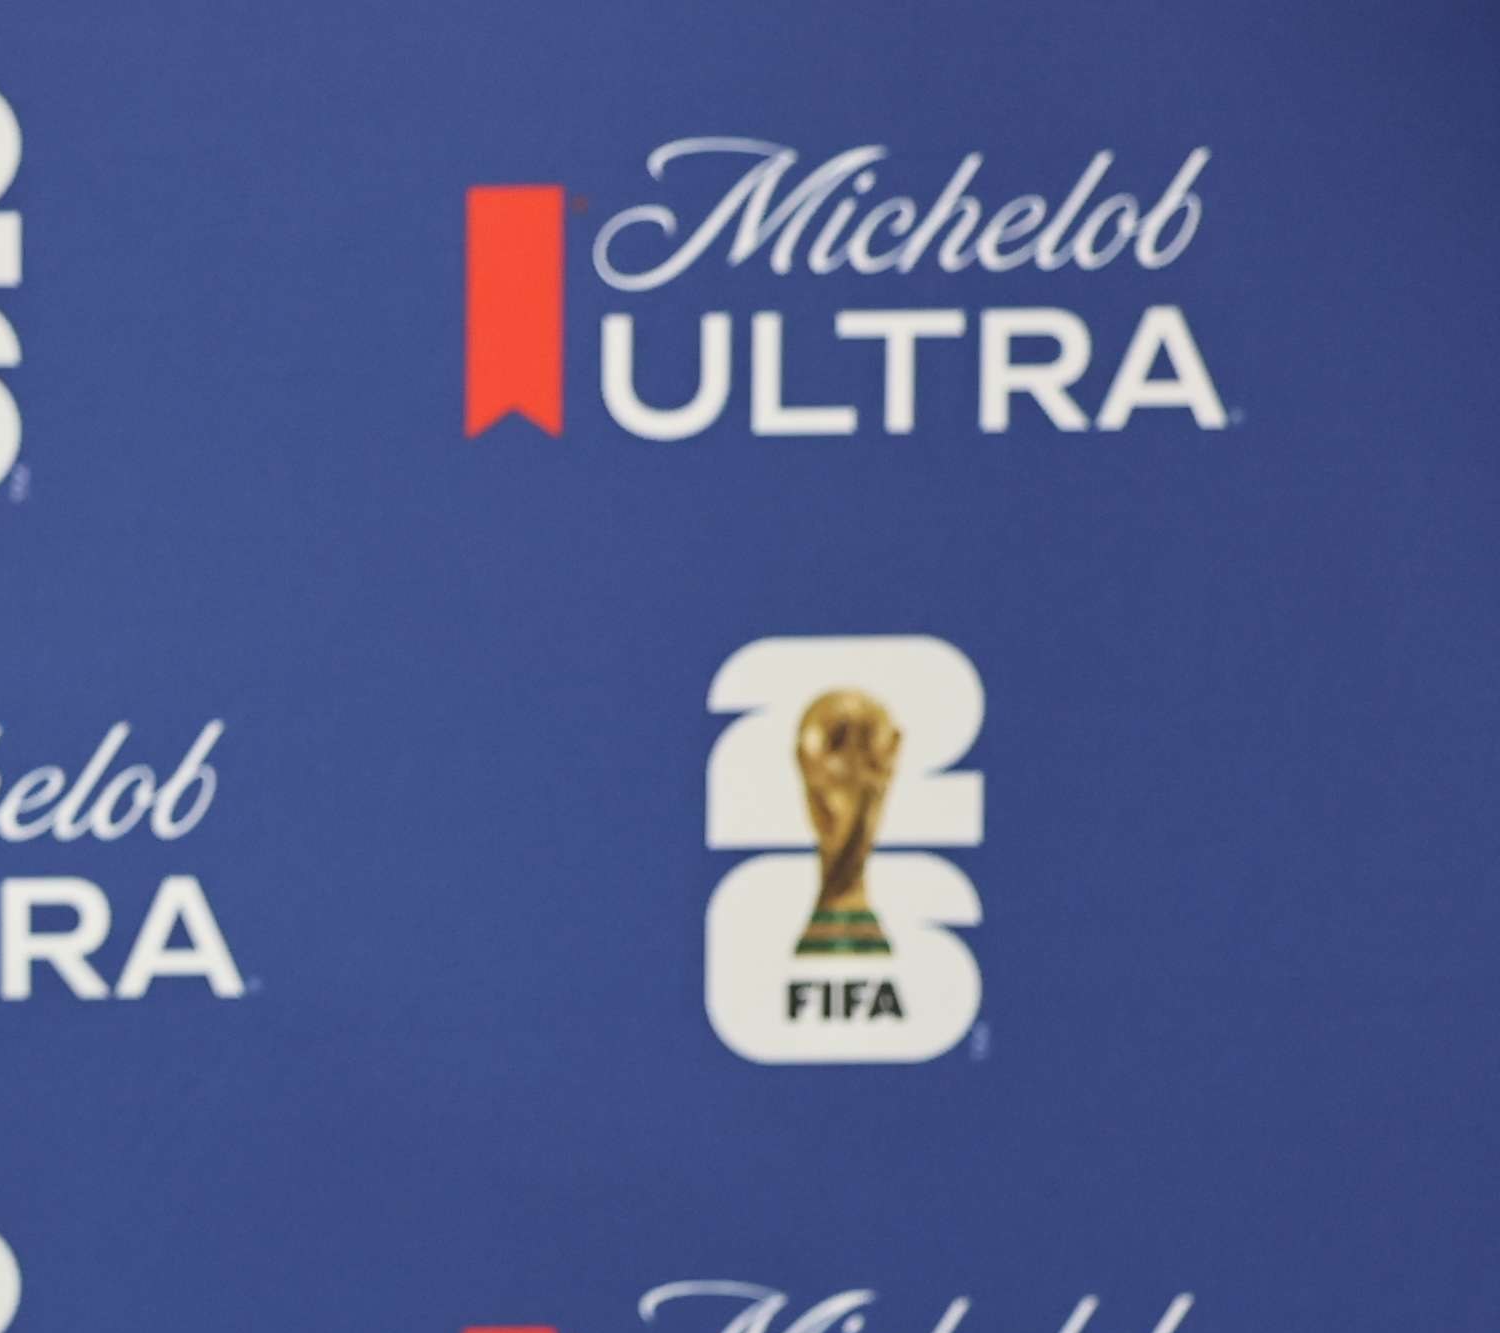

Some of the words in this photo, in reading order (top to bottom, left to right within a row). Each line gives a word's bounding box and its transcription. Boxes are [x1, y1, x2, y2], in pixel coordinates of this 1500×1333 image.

[593, 137, 1209, 291] Michelob
[602, 306, 1226, 440] ULTRA
[788, 981, 903, 1019] FIFA
